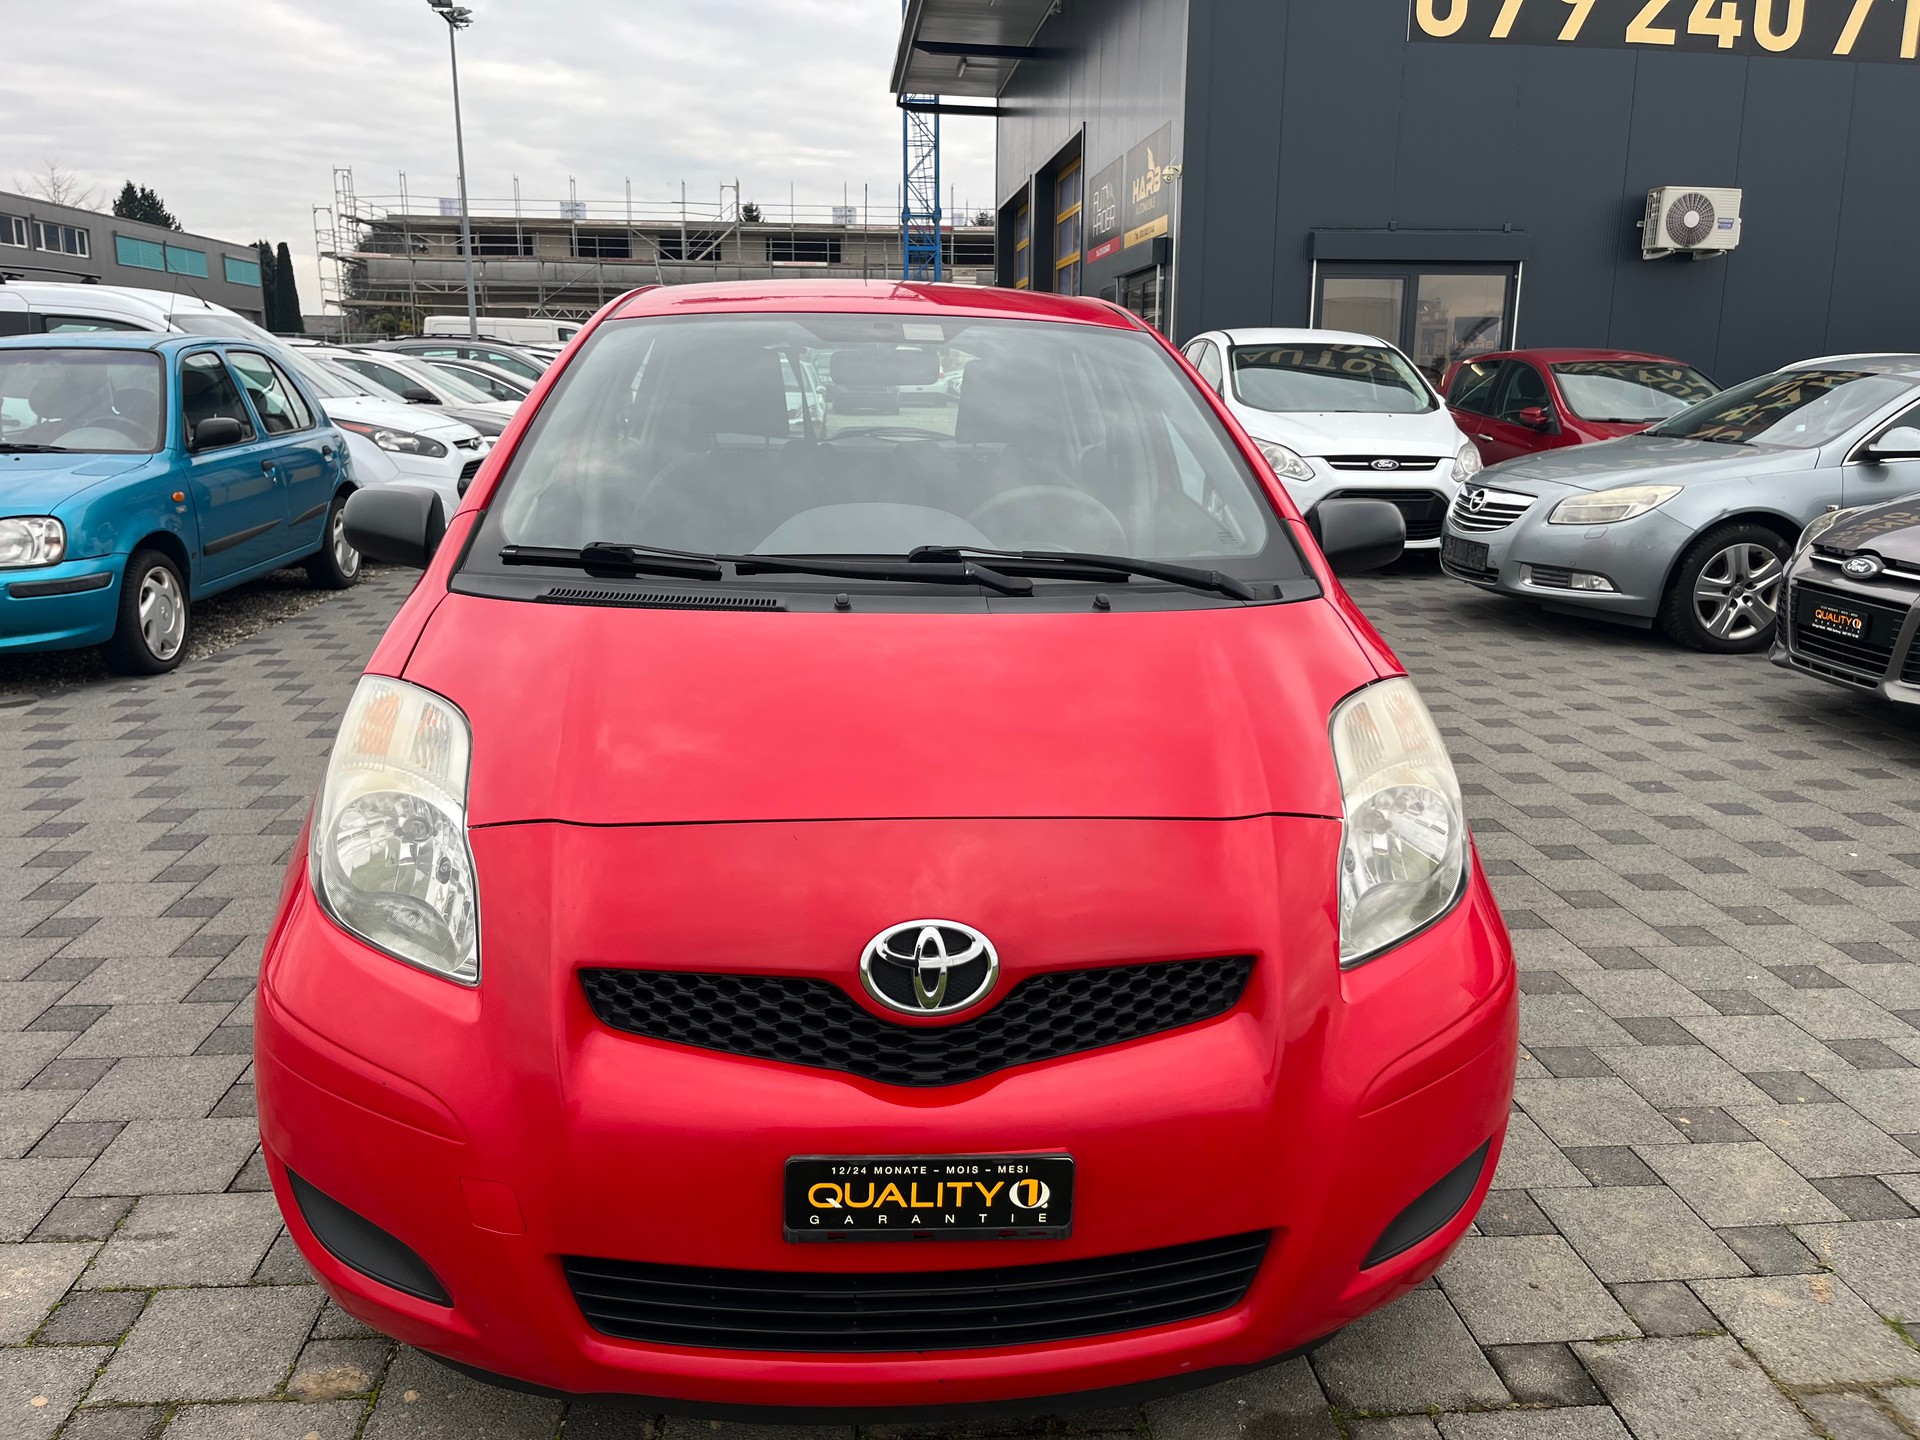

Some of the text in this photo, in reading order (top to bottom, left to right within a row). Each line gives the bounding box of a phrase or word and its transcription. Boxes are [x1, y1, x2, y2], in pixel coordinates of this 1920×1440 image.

[1132, 166, 1161, 204] HARB
[1814, 609, 1852, 626] QUALITY
[831, 1166, 867, 1175] 12/24
[873, 1166, 928, 1175] MONATE
[946, 1165, 979, 1175] MOIS
[997, 1165, 1029, 1174] MESI
[808, 1181, 1005, 1209] QUALITY
[810, 1213, 1047, 1225] GARANTIE
